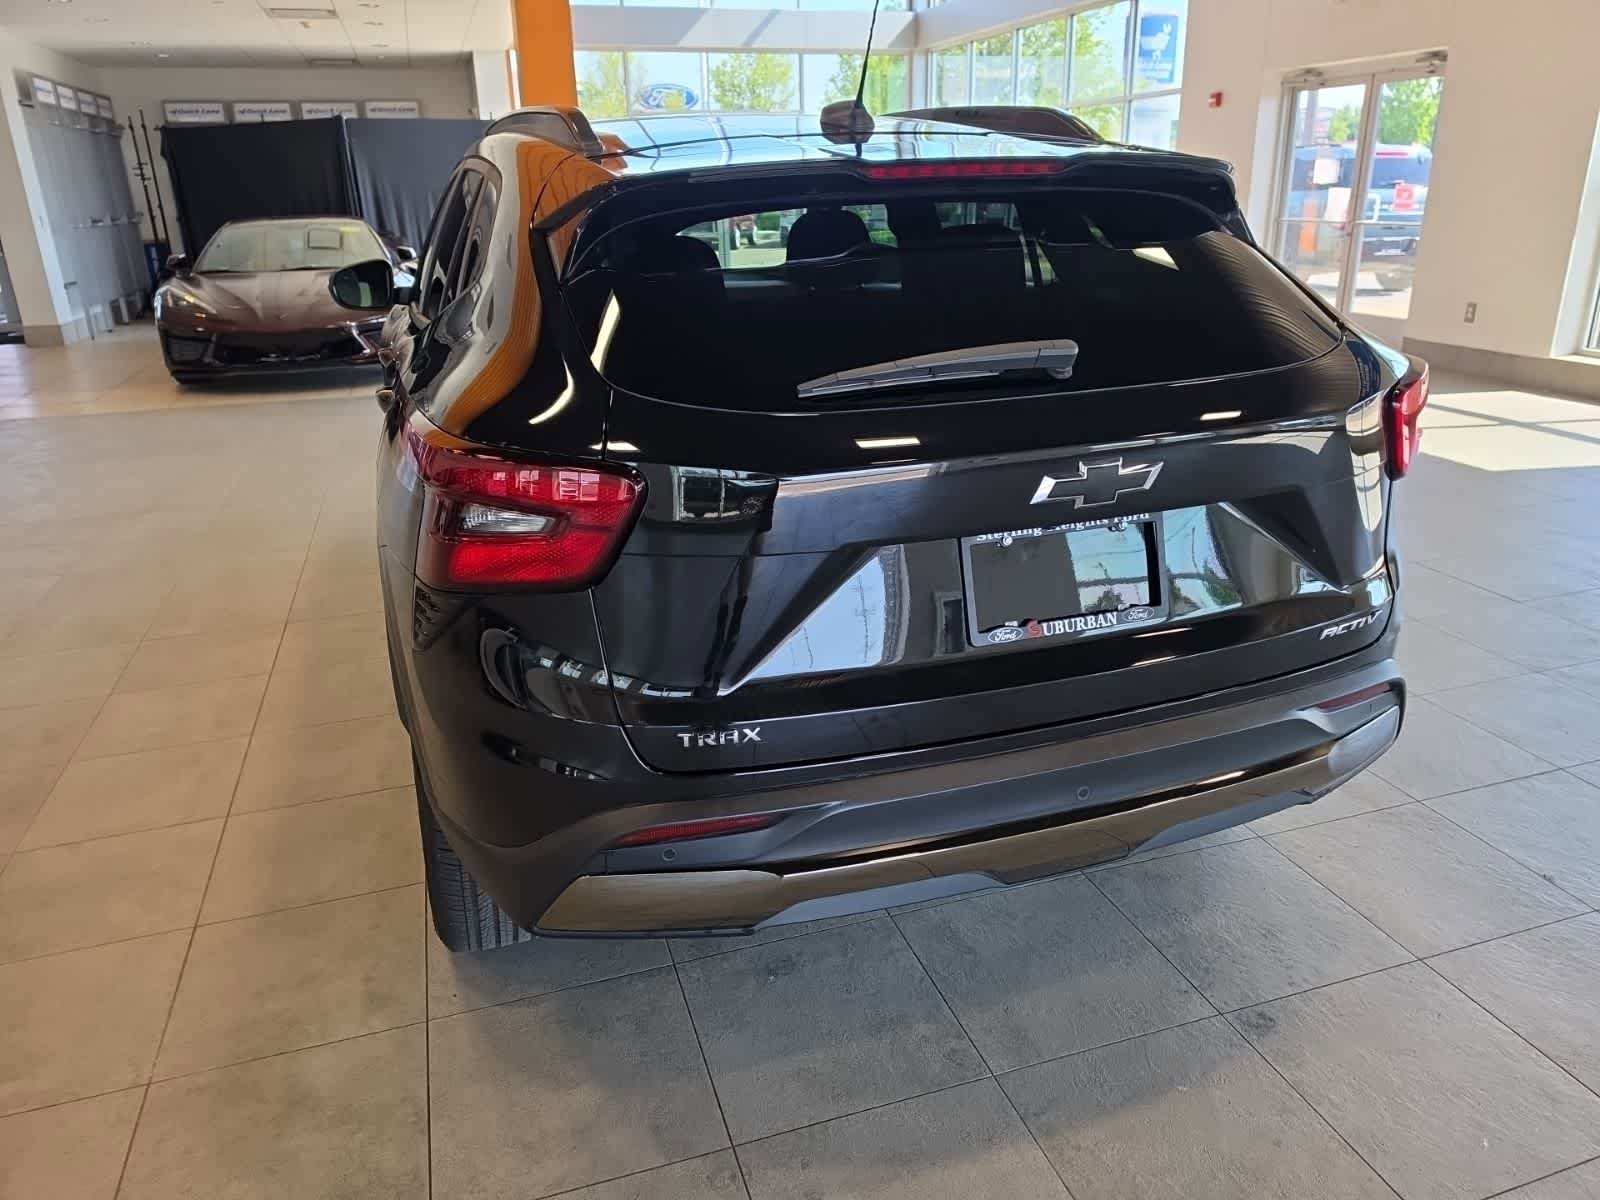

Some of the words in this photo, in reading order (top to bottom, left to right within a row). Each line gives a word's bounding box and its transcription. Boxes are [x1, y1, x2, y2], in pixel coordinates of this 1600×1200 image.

[1028, 611, 1118, 639] SUBURBAN
[1320, 609, 1383, 640] ACTIV
[677, 727, 761, 748] TRAX
